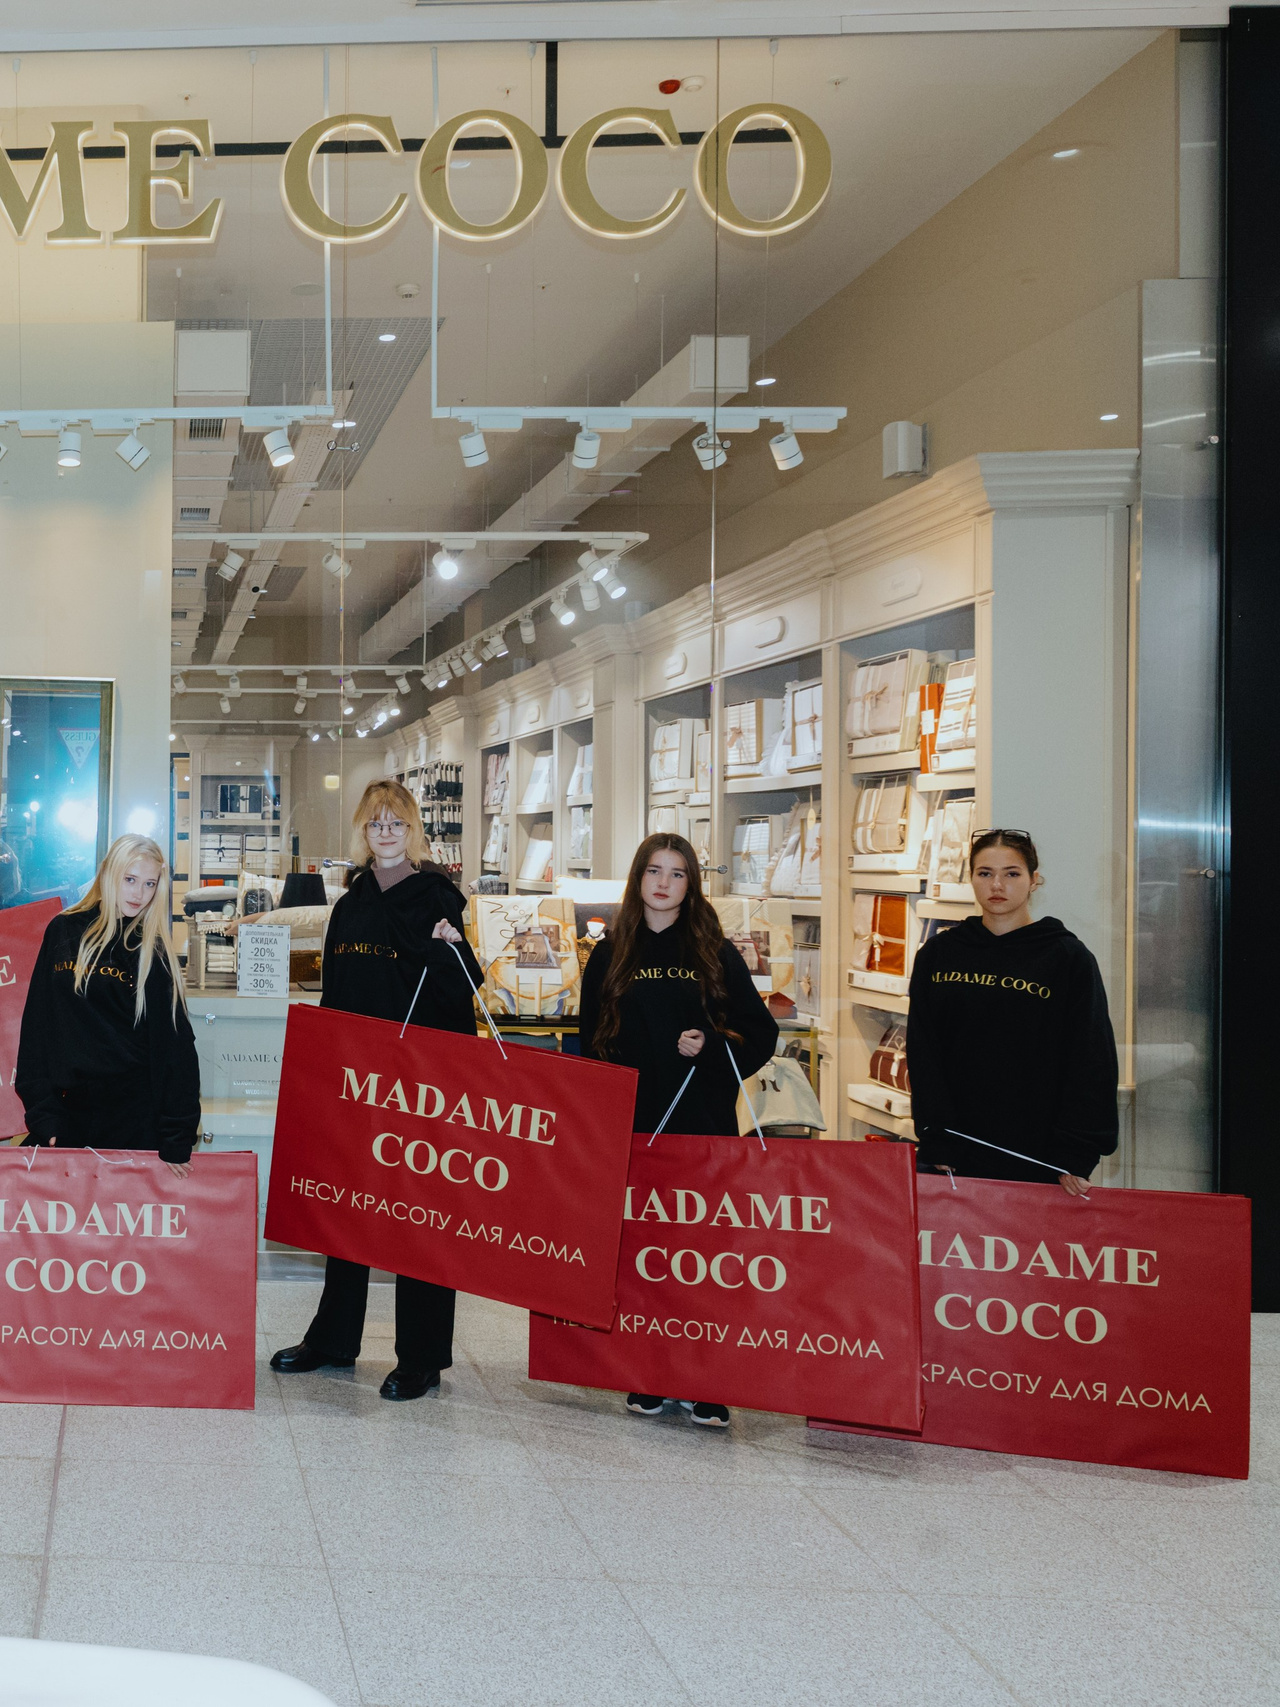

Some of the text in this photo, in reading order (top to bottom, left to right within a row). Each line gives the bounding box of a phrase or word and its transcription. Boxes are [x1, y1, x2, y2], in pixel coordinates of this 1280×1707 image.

[282, 103, 832, 244] COCO
[251, 937, 278, 945] СКИДКА
[251, 947, 275, 957] -20%
[100, 966, 130, 982] COC
[250, 963, 274, 973] -25%
[250, 978, 274, 989] -30%
[667, 967, 701, 981] COC
[932, 971, 1051, 999] MADAME COCO
[221, 1053, 270, 1063] MADAME
[339, 1067, 557, 1146] MADAME
[372, 1133, 508, 1191] COCO
[291, 1176, 585, 1266] НЕСУ КРАСОТУ ДЛЯ ДОМА
[5, 1257, 146, 1295] COCO
[636, 1247, 786, 1292] COCO
[935, 1293, 1107, 1344] COCO
[99, 1329, 144, 1349] ДЛЯ
[152, 1331, 227, 1351] ДОМА
[620, 1314, 729, 1342] КРАСОТУ
[737, 1327, 787, 1349] ДЛЯ
[796, 1333, 884, 1359] ДОМА
[1050, 1379, 1106, 1401] ДЛЯ
[1116, 1386, 1211, 1413] ДОМА
